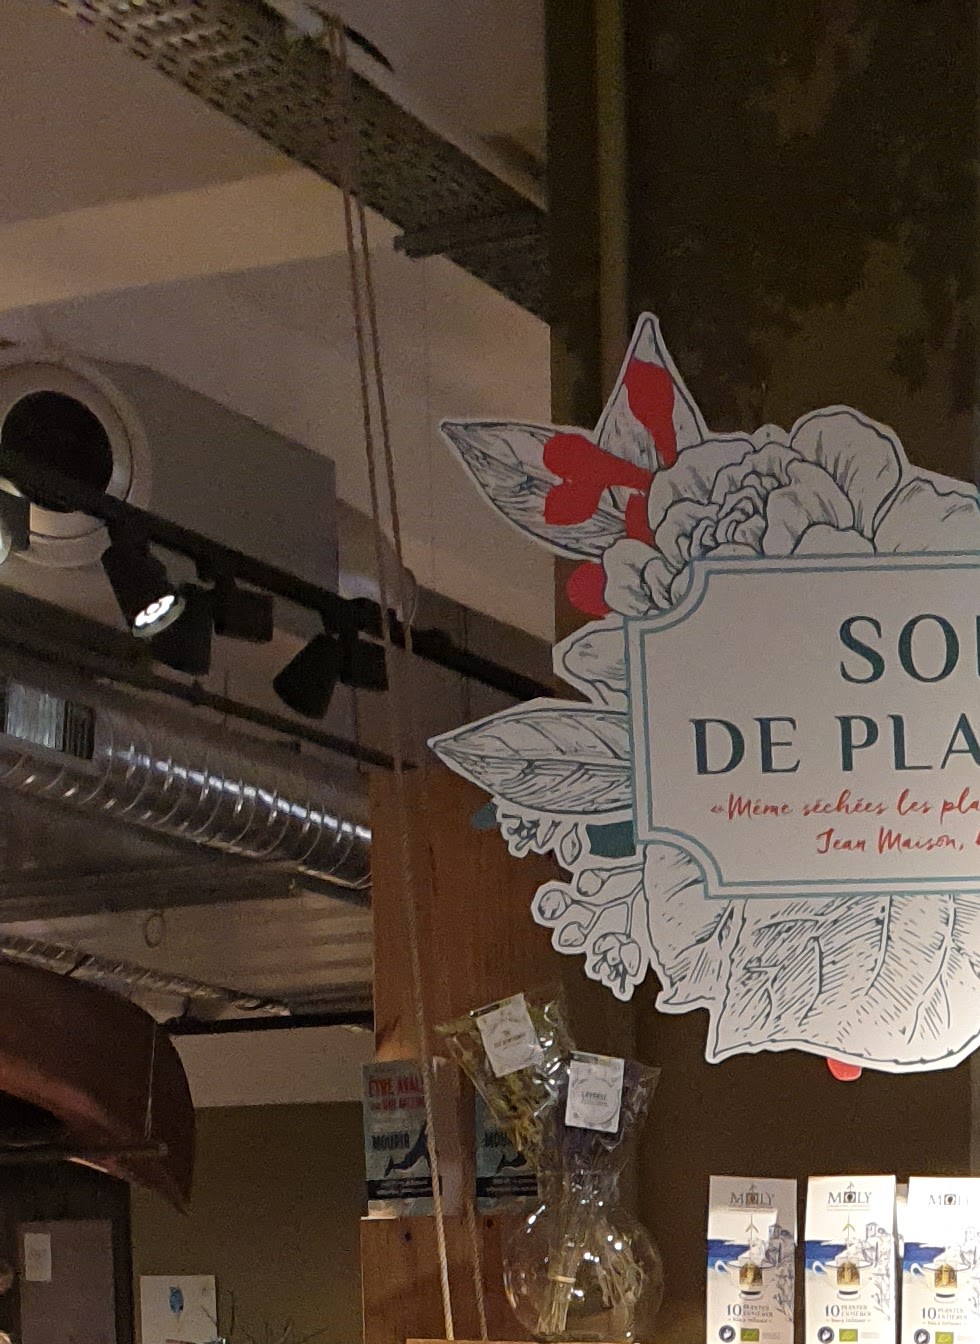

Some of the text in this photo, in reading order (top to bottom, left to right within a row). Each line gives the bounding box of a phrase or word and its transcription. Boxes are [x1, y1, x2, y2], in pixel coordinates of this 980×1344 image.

[688, 715, 801, 776] DE
[802, 788, 887, 819] séchées
[896, 788, 933, 816] les
[815, 828, 867, 855] Jean
[878, 825, 964, 854] Maison,
[827, 1190, 872, 1204] MOLY
[726, 1303, 742, 1317] 10
[825, 1304, 840, 1317] 10
[921, 1307, 937, 1320] 10
